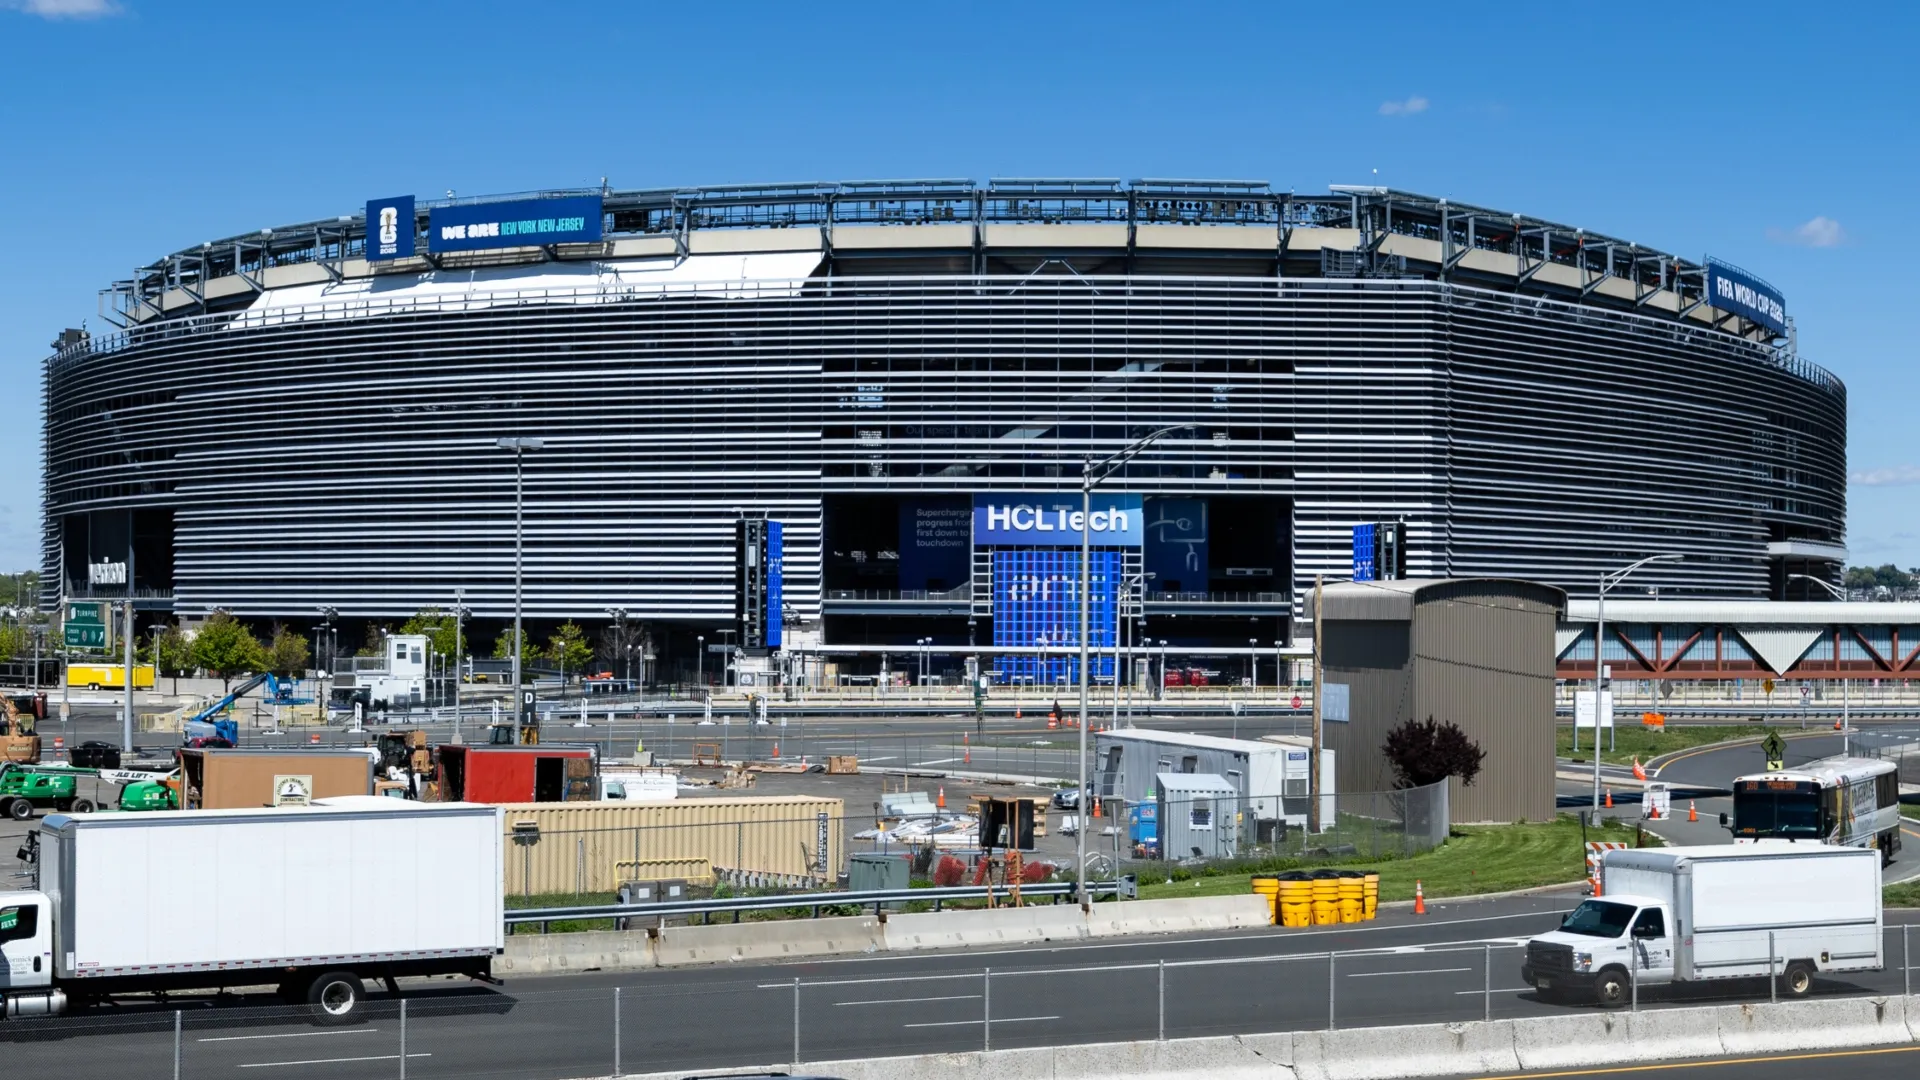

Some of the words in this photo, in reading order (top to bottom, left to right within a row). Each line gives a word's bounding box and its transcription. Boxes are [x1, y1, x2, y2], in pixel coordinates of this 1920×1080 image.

[441, 225, 466, 240] WE
[467, 222, 500, 238] ARE
[501, 221, 517, 236] NEW
[518, 219, 537, 234] YORK
[537, 218, 555, 233] NEW
[556, 216, 585, 232] JERSEY
[1717, 275, 1734, 300] FIFA
[1734, 282, 1757, 309] WORLD
[1757, 293, 1770, 315] CUP
[1769, 299, 1784, 324] 2026
[987, 503, 1128, 532] HCLTech
[916, 520, 953, 529] progress
[916, 529, 934, 537] first
[934, 529, 958, 537] down
[960, 529, 969, 537] to
[916, 539, 964, 547] touchdown
[77, 609, 98, 618] TURNPIKE
[525, 692, 534, 704] D
[526, 711, 531, 723] 1
